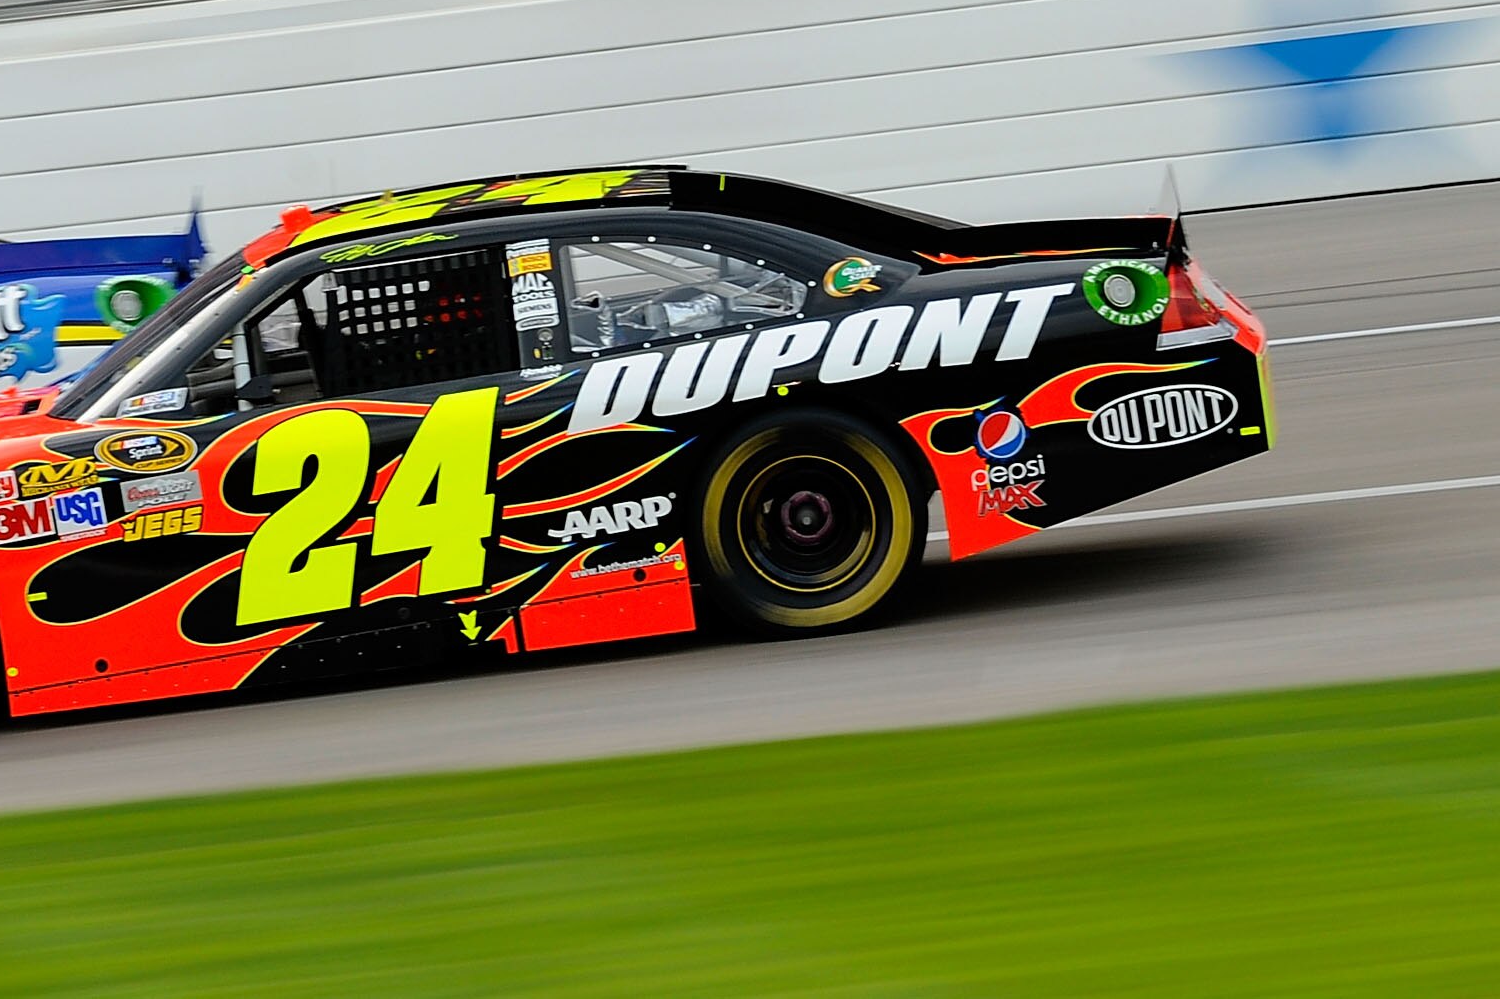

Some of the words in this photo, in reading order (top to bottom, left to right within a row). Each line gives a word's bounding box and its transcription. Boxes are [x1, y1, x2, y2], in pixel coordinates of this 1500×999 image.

[511, 272, 555, 297] MAC
[1083, 258, 1160, 283] AMERICAN
[512, 290, 556, 303] TOOLS
[1097, 296, 1170, 326] ETHANOL
[566, 283, 1076, 436] DUPONT
[1100, 398, 1143, 444] DU
[1143, 389, 1225, 443] PONT
[128, 444, 163, 460] Sprint
[970, 453, 1047, 492] pepsi
[54, 491, 104, 527] USG
[235, 386, 500, 626] 24
[976, 479, 1049, 518] MAX
[123, 505, 204, 543] JEGS
[547, 495, 673, 543] AARP
[569, 553, 682, 579] www.bethematch.org
